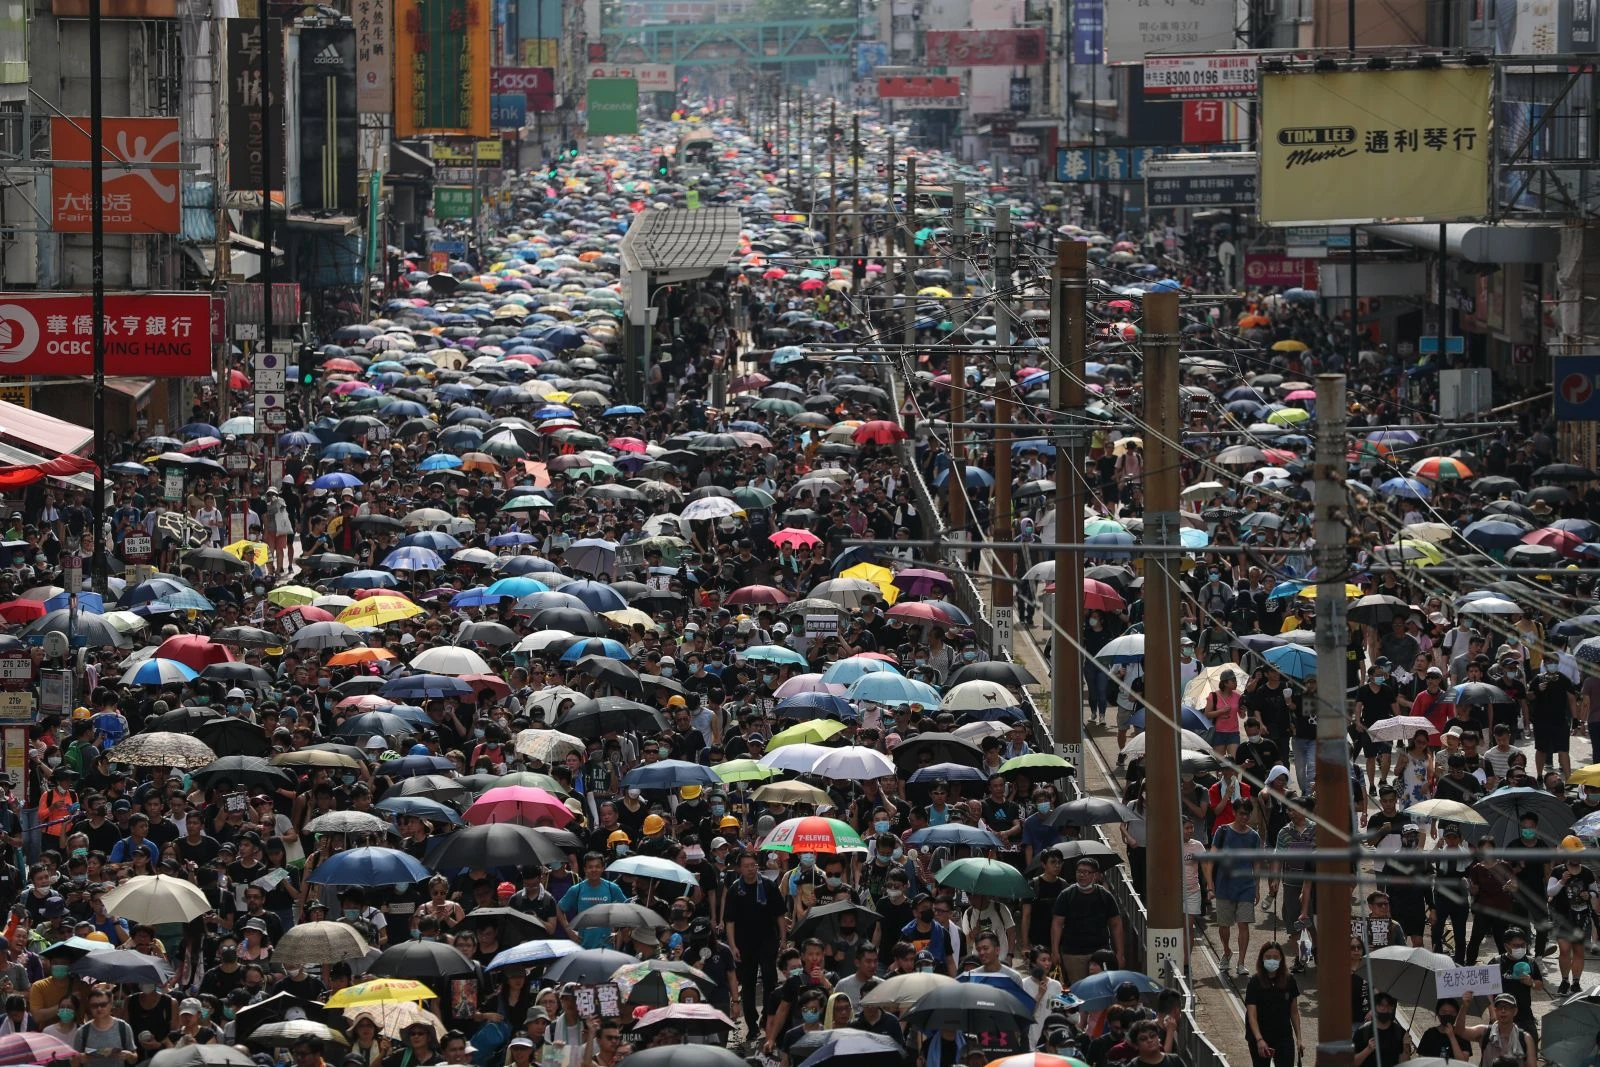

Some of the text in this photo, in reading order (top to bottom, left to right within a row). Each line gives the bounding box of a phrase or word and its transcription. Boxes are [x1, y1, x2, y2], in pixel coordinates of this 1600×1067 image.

[1176, 33, 1198, 42] 1330
[313, 56, 344, 64] adidas
[1166, 71, 1190, 85] 8300
[1193, 70, 1218, 84] 0196
[1243, 69, 1256, 82] 83
[491, 105, 519, 119] ank
[1195, 101, 1217, 122] 行
[1285, 128, 1350, 143] TOM LEE
[1365, 127, 1477, 153] 通利琴行
[1285, 145, 1358, 169] Music
[58, 212, 132, 223] Fairood
[47, 315, 192, 338] 華僑永亨銀行
[47, 340, 91, 355] OCBC
[145, 342, 192, 356] HANG
[276, 371, 281, 379] 7
[995, 609, 1011, 618] 590
[997, 620, 1009, 629] PL
[999, 631, 1009, 639] 18
[2, 660, 14, 668] 276
[1062, 743, 1080, 754] 590
[1155, 937, 1177, 948] 590
[1443, 969, 1490, 988] 免於恐懼
